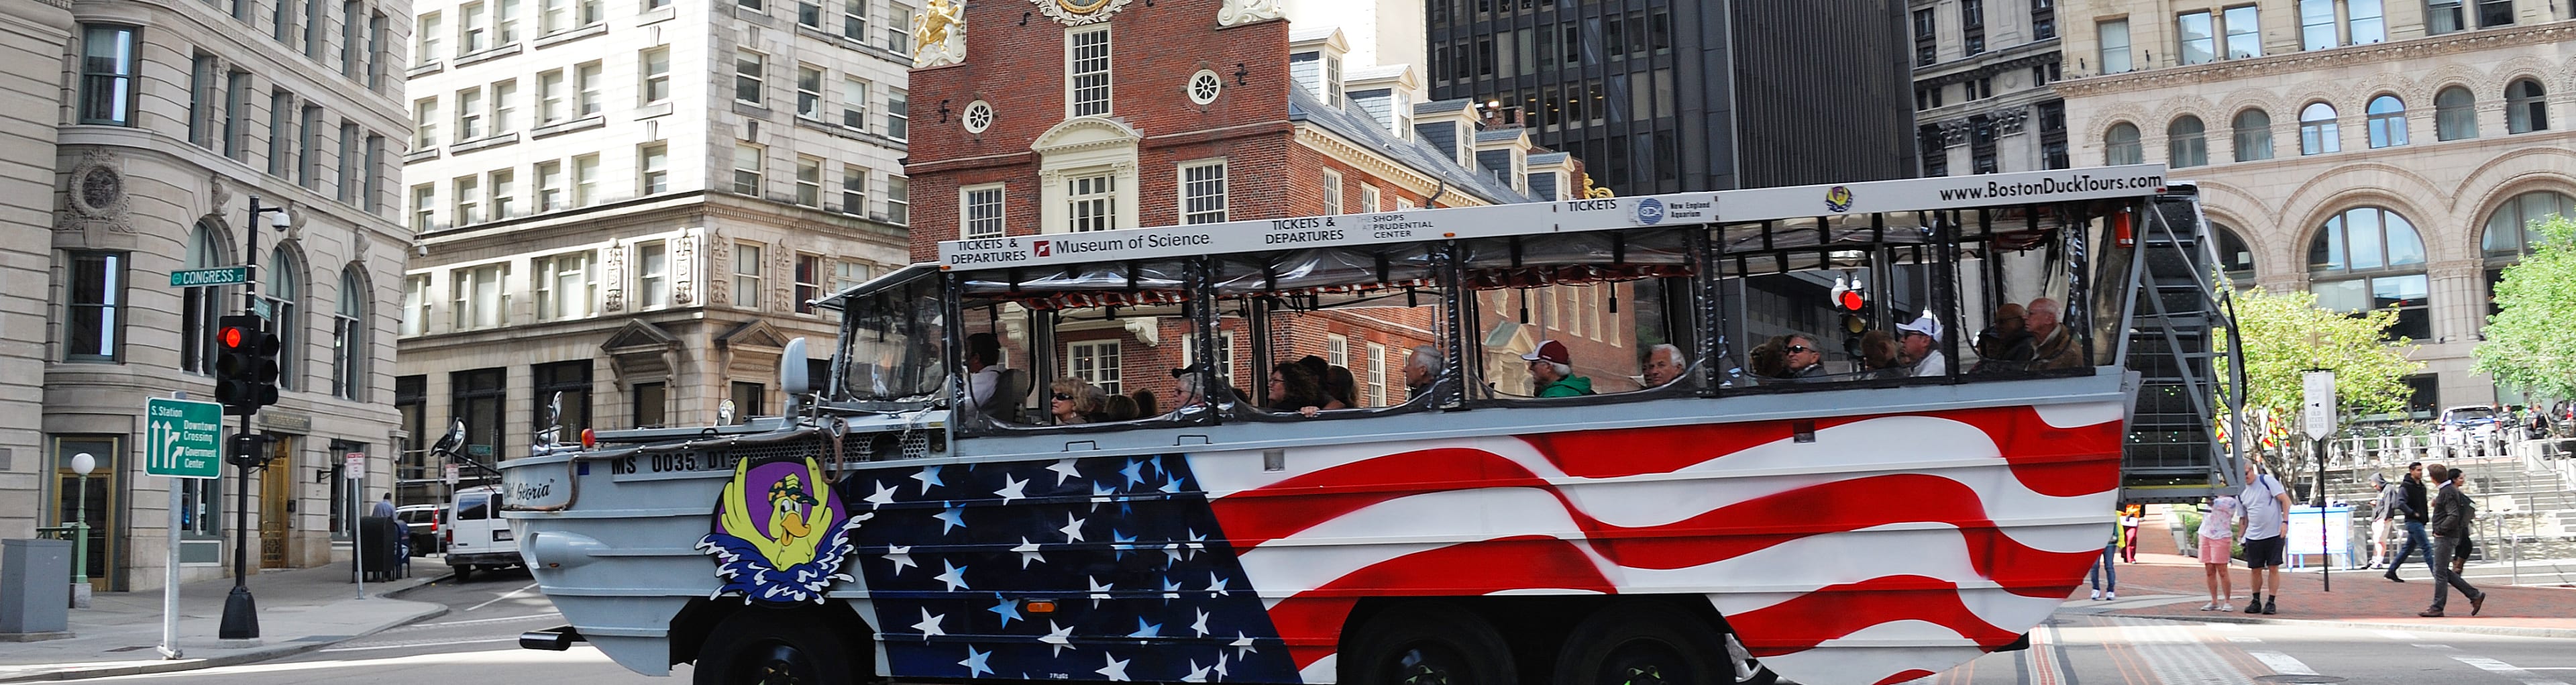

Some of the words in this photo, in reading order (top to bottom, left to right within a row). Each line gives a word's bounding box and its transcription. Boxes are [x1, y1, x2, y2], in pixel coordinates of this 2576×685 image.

[1939, 174, 2161, 201] www.BostonDuckTours.com
[1568, 199, 1617, 211] TICKETS
[1686, 201, 1710, 209] England
[1671, 211, 1701, 219] Aquarium
[1272, 218, 1319, 230] TICKETS
[1326, 217, 1336, 227] &
[1373, 221, 1434, 230] PRUDENTIAL
[1265, 229, 1344, 244] DEPARTURES
[1374, 230, 1411, 238] CENTER
[957, 239, 1002, 251] TICKETS
[1009, 238, 1018, 248] &
[1056, 240, 1123, 254] Museum
[1128, 235, 1143, 249] of
[951, 251, 1026, 264] DEPARTURES
[183, 269, 233, 284] CONGRESS
[158, 406, 182, 417] Station
[184, 420, 217, 431] Downtown
[184, 431, 213, 445] Crossing
[184, 458, 205, 468] Center
[612, 456, 636, 474] MS
[652, 453, 696, 472] 0035
[708, 450, 727, 468] DT
